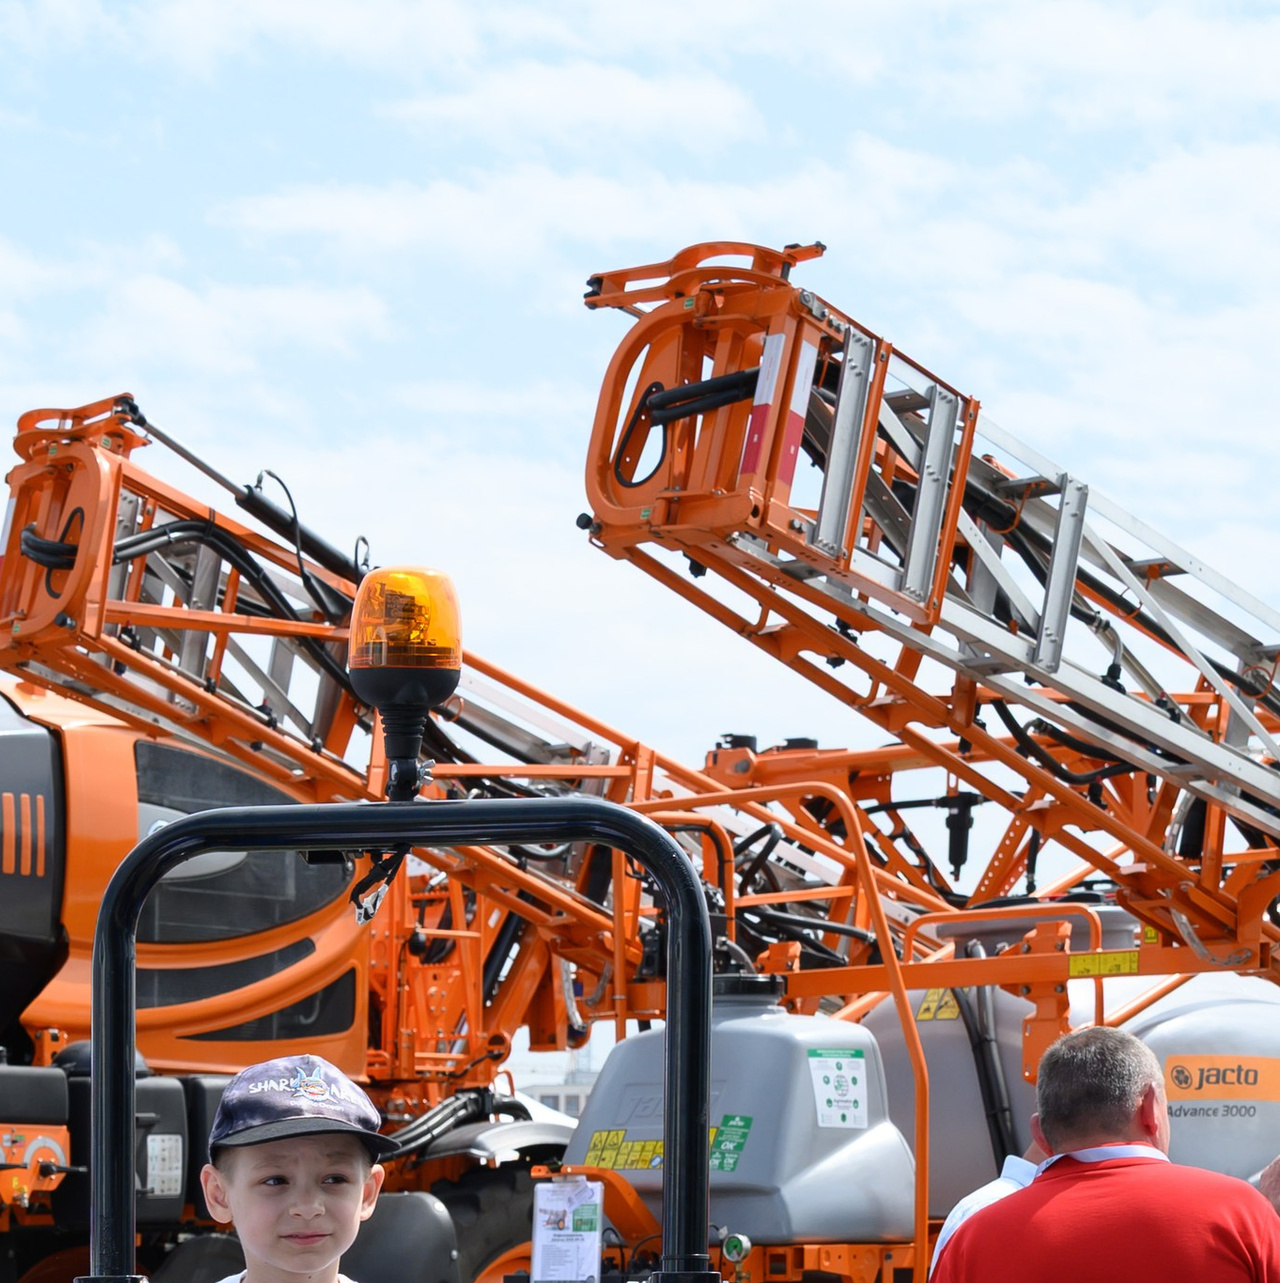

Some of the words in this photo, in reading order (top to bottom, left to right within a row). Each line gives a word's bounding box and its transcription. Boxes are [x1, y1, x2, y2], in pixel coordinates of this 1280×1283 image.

[1195, 1065, 1259, 1090] jacto
[1167, 1105, 1219, 1117] Advance
[1221, 1105, 1256, 1117] 3000
[720, 1141, 738, 1150] OK
